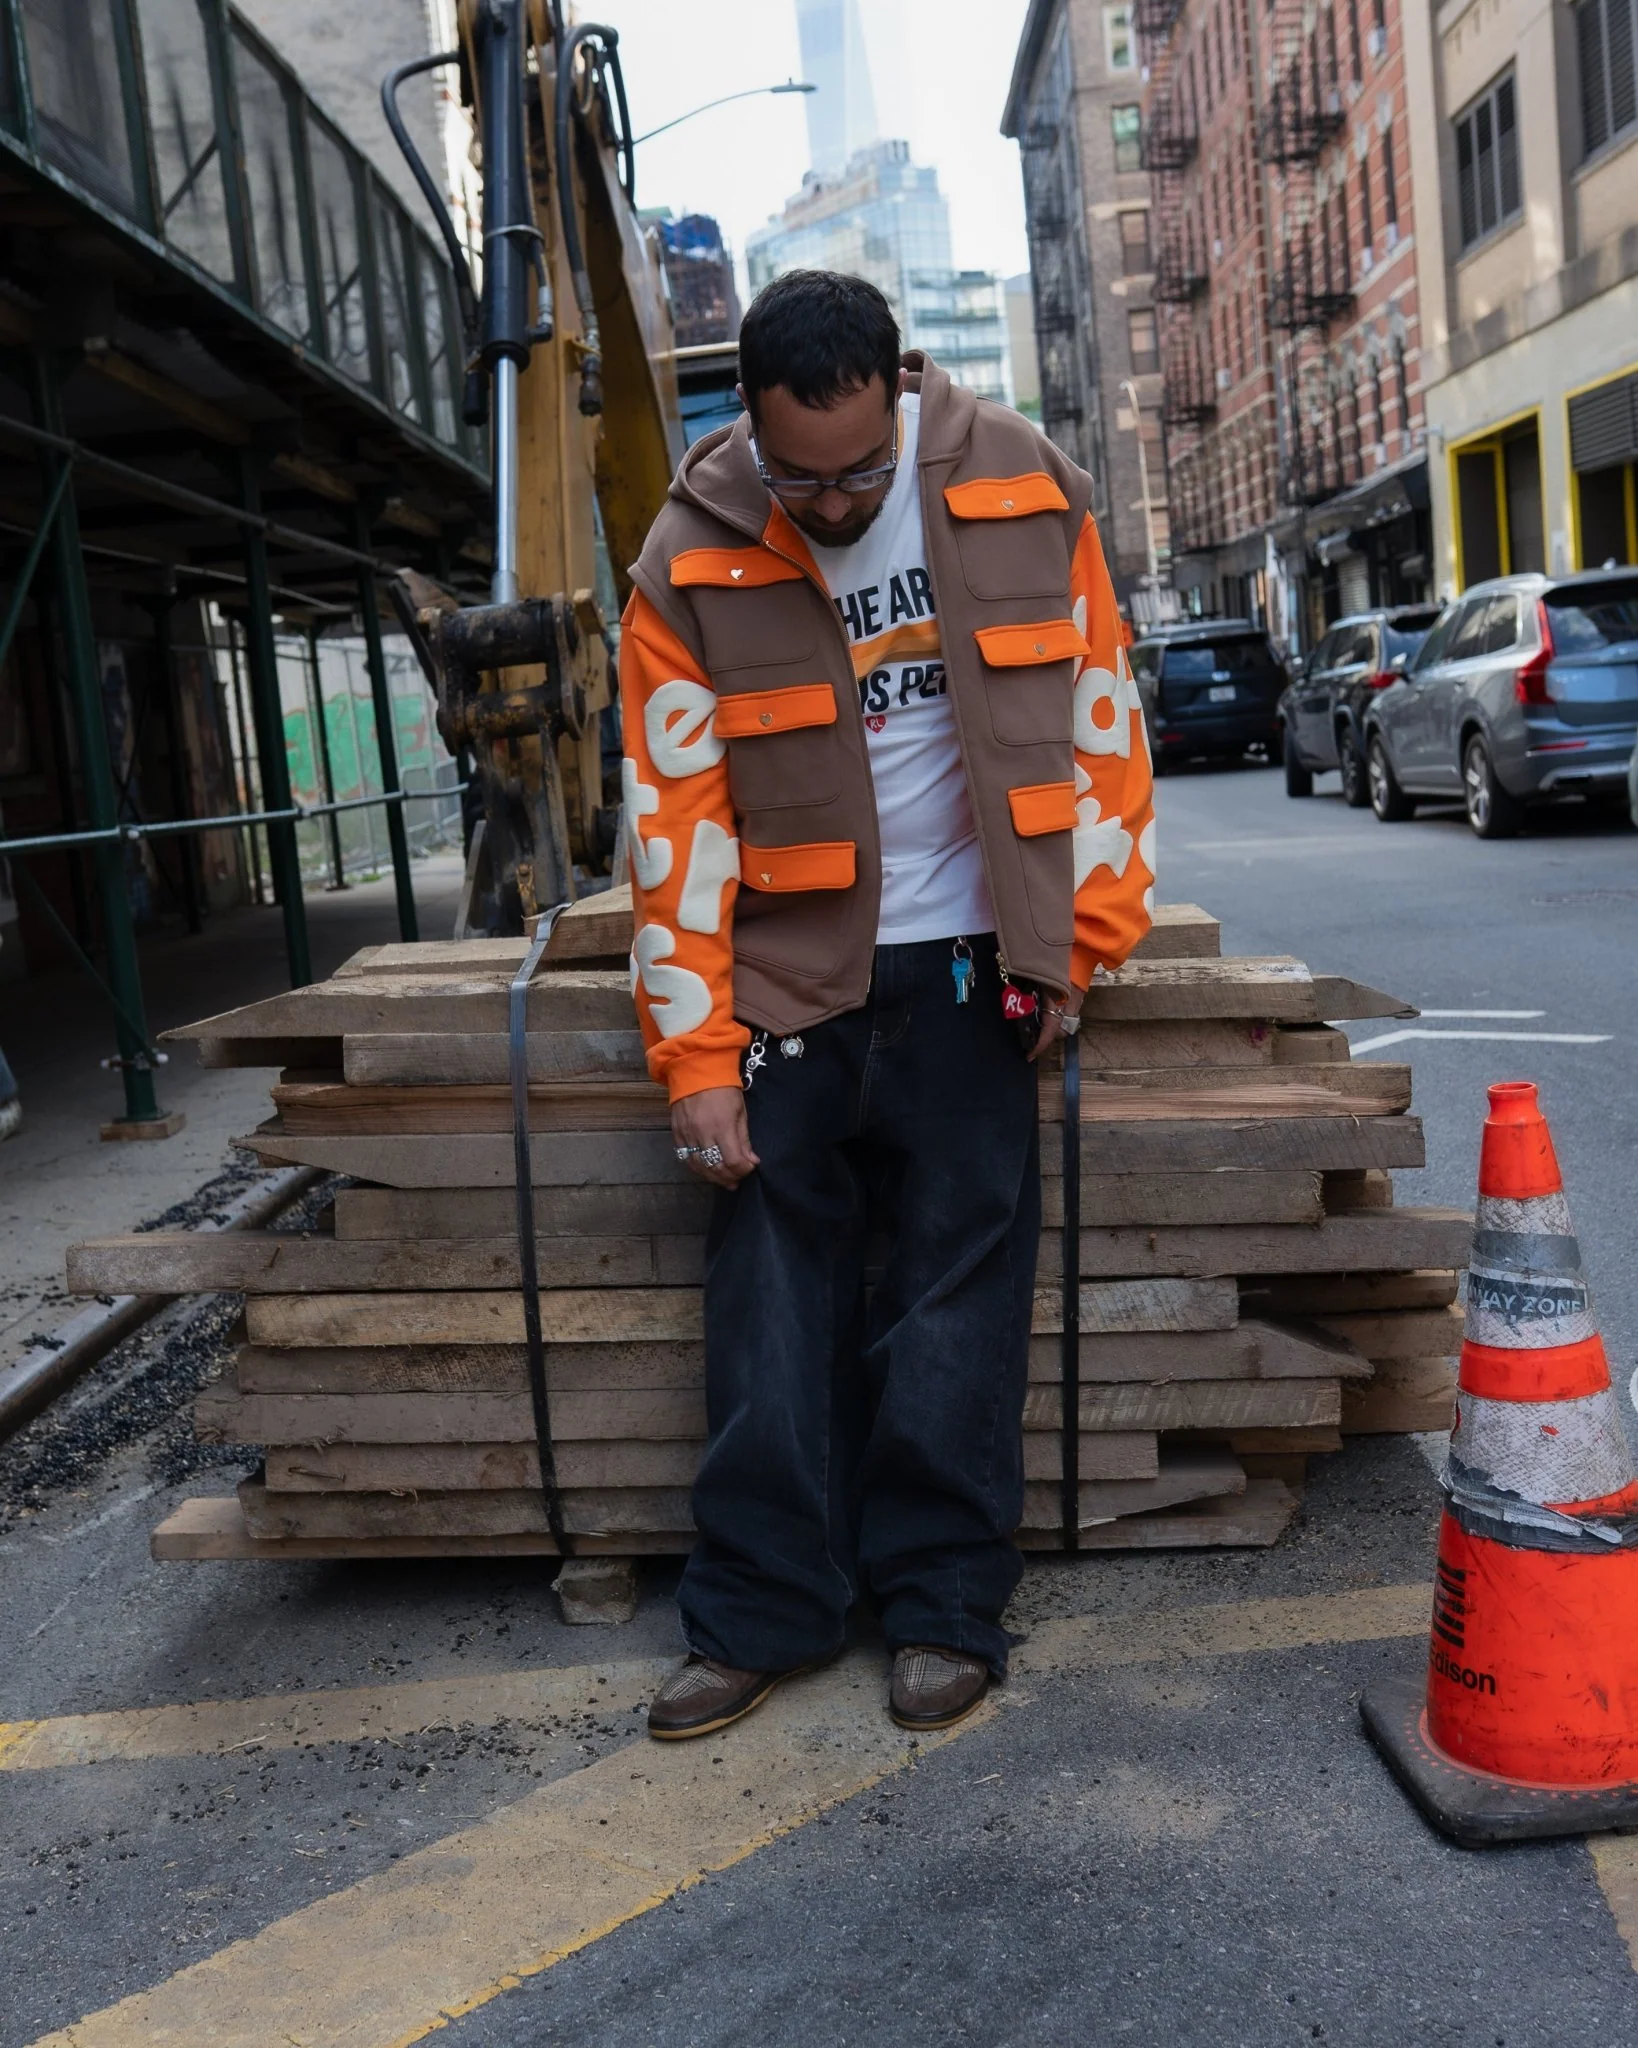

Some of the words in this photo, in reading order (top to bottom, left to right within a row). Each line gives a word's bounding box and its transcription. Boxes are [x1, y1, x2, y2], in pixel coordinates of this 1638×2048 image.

[870, 718, 885, 729] RL
[1005, 993, 1025, 1015] RL
[1521, 1296, 1581, 1316] ZONE
